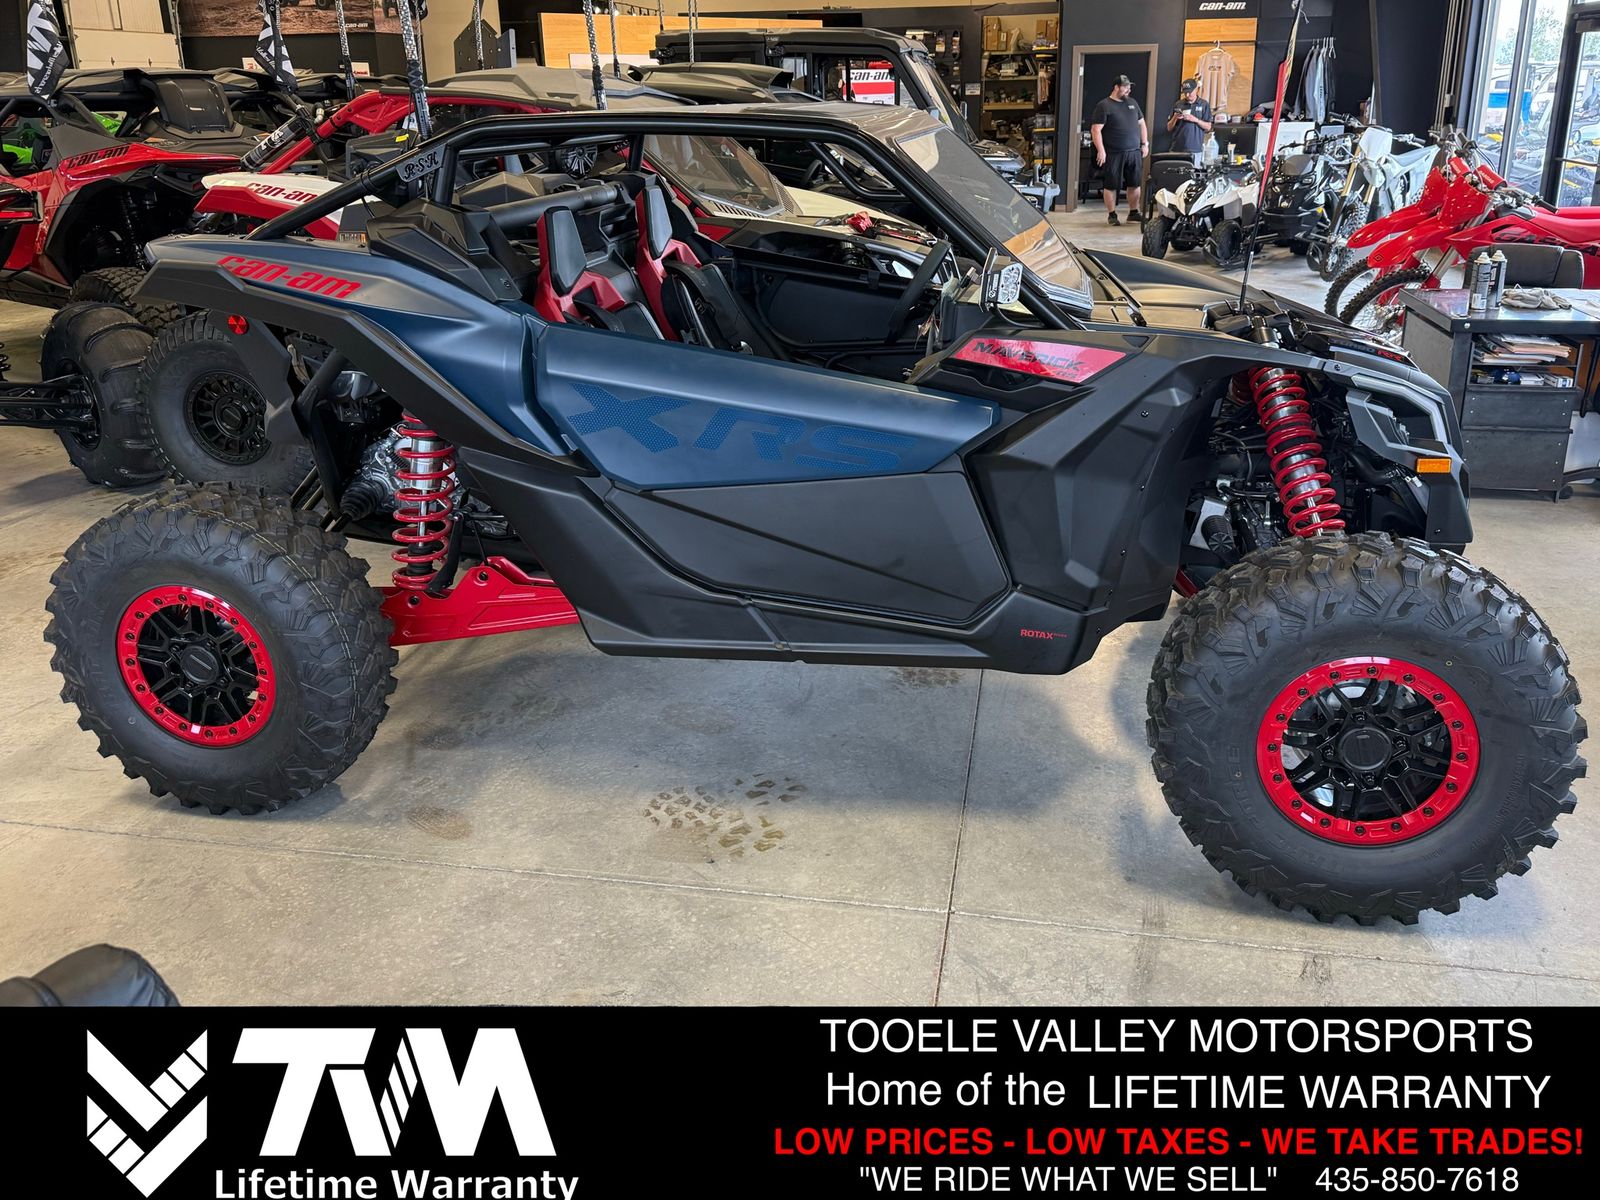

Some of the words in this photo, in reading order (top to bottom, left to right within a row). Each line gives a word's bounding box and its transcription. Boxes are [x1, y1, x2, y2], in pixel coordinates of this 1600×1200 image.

[1199, 2, 1247, 11] can-am
[67, 145, 130, 169] can-am
[217, 255, 362, 299] can-am
[974, 341, 1086, 372] MAVERICK
[1020, 628, 1054, 640] ROTAX
